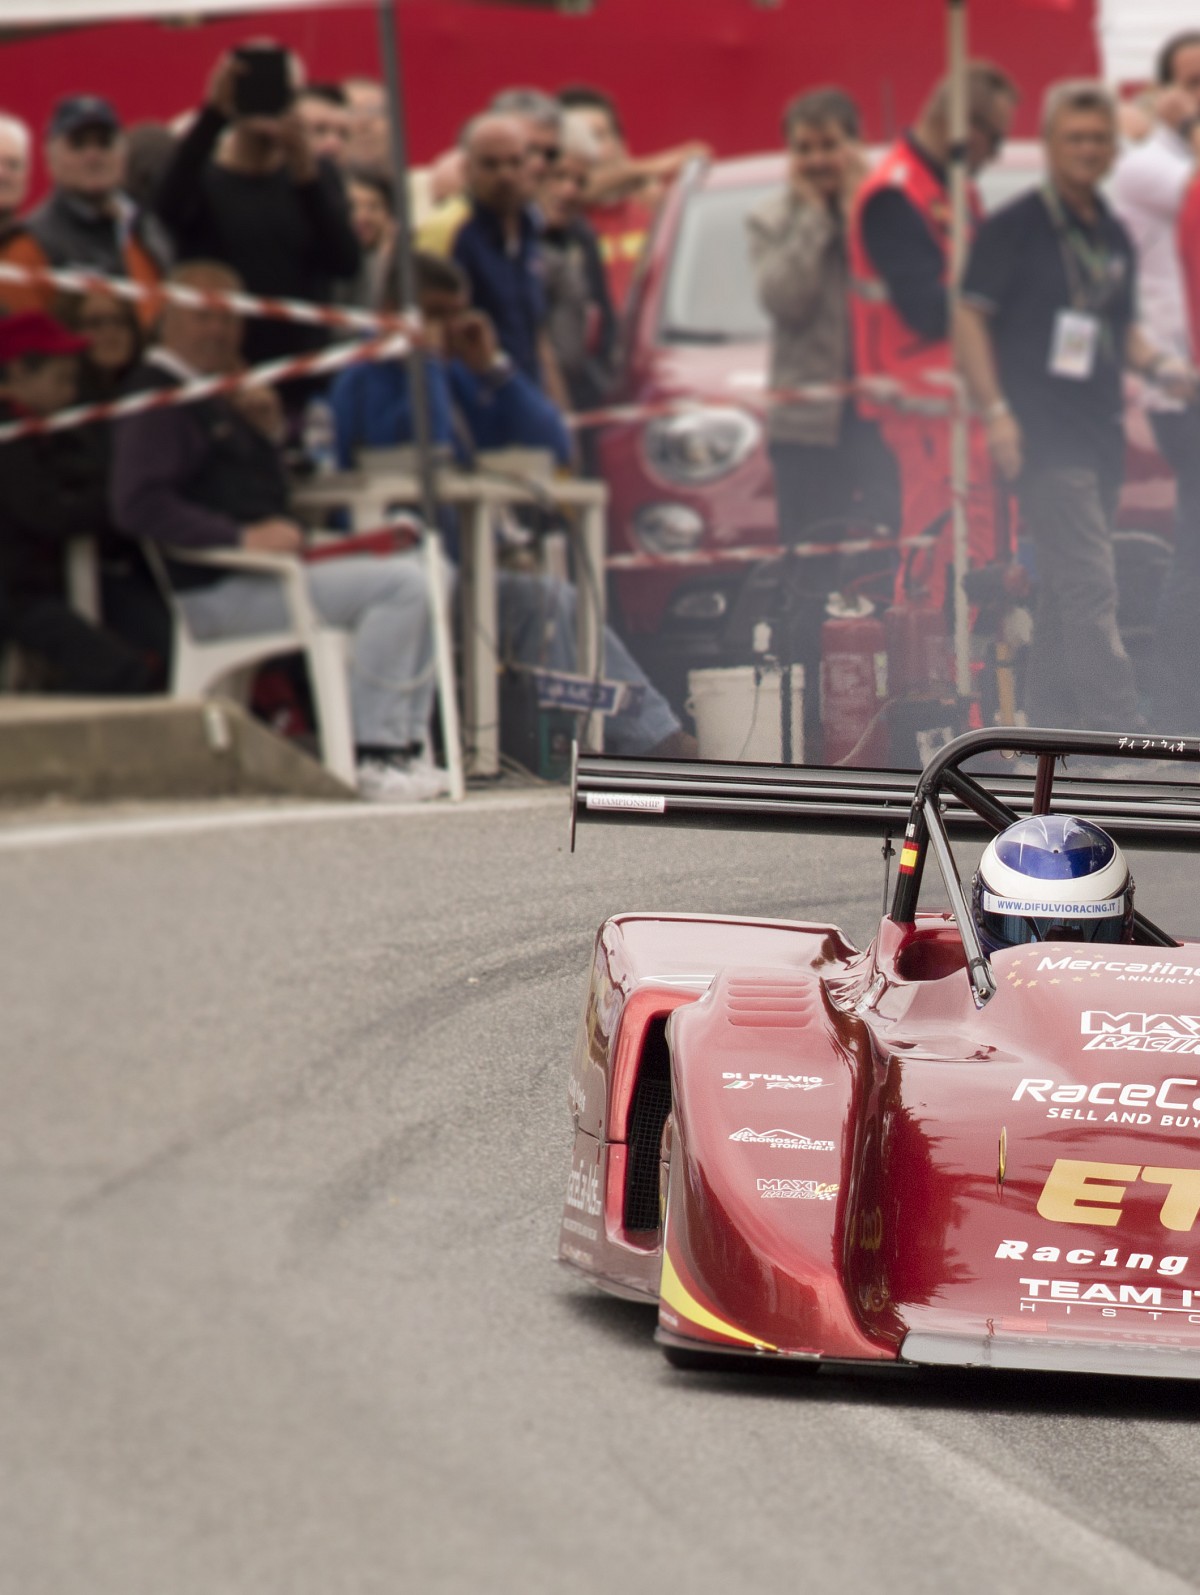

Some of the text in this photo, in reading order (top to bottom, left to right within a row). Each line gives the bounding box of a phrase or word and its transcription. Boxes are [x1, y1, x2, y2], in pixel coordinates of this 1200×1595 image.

[591, 797, 660, 808] CHAMPIONSHIP
[997, 900, 1116, 914] WWW.DIFULVIORACING.IT
[1116, 974, 1194, 985] ANNUNCI
[749, 1073, 823, 1083] FULVIO
[1046, 1108, 1097, 1120] SELL
[1104, 1116, 1150, 1125] AND
[741, 1136, 835, 1146] CRONOSCALATE
[769, 1143, 836, 1151] STORICHE.IT
[756, 1178, 818, 1192] MAXI
[1019, 1278, 1162, 1305] TEAM
